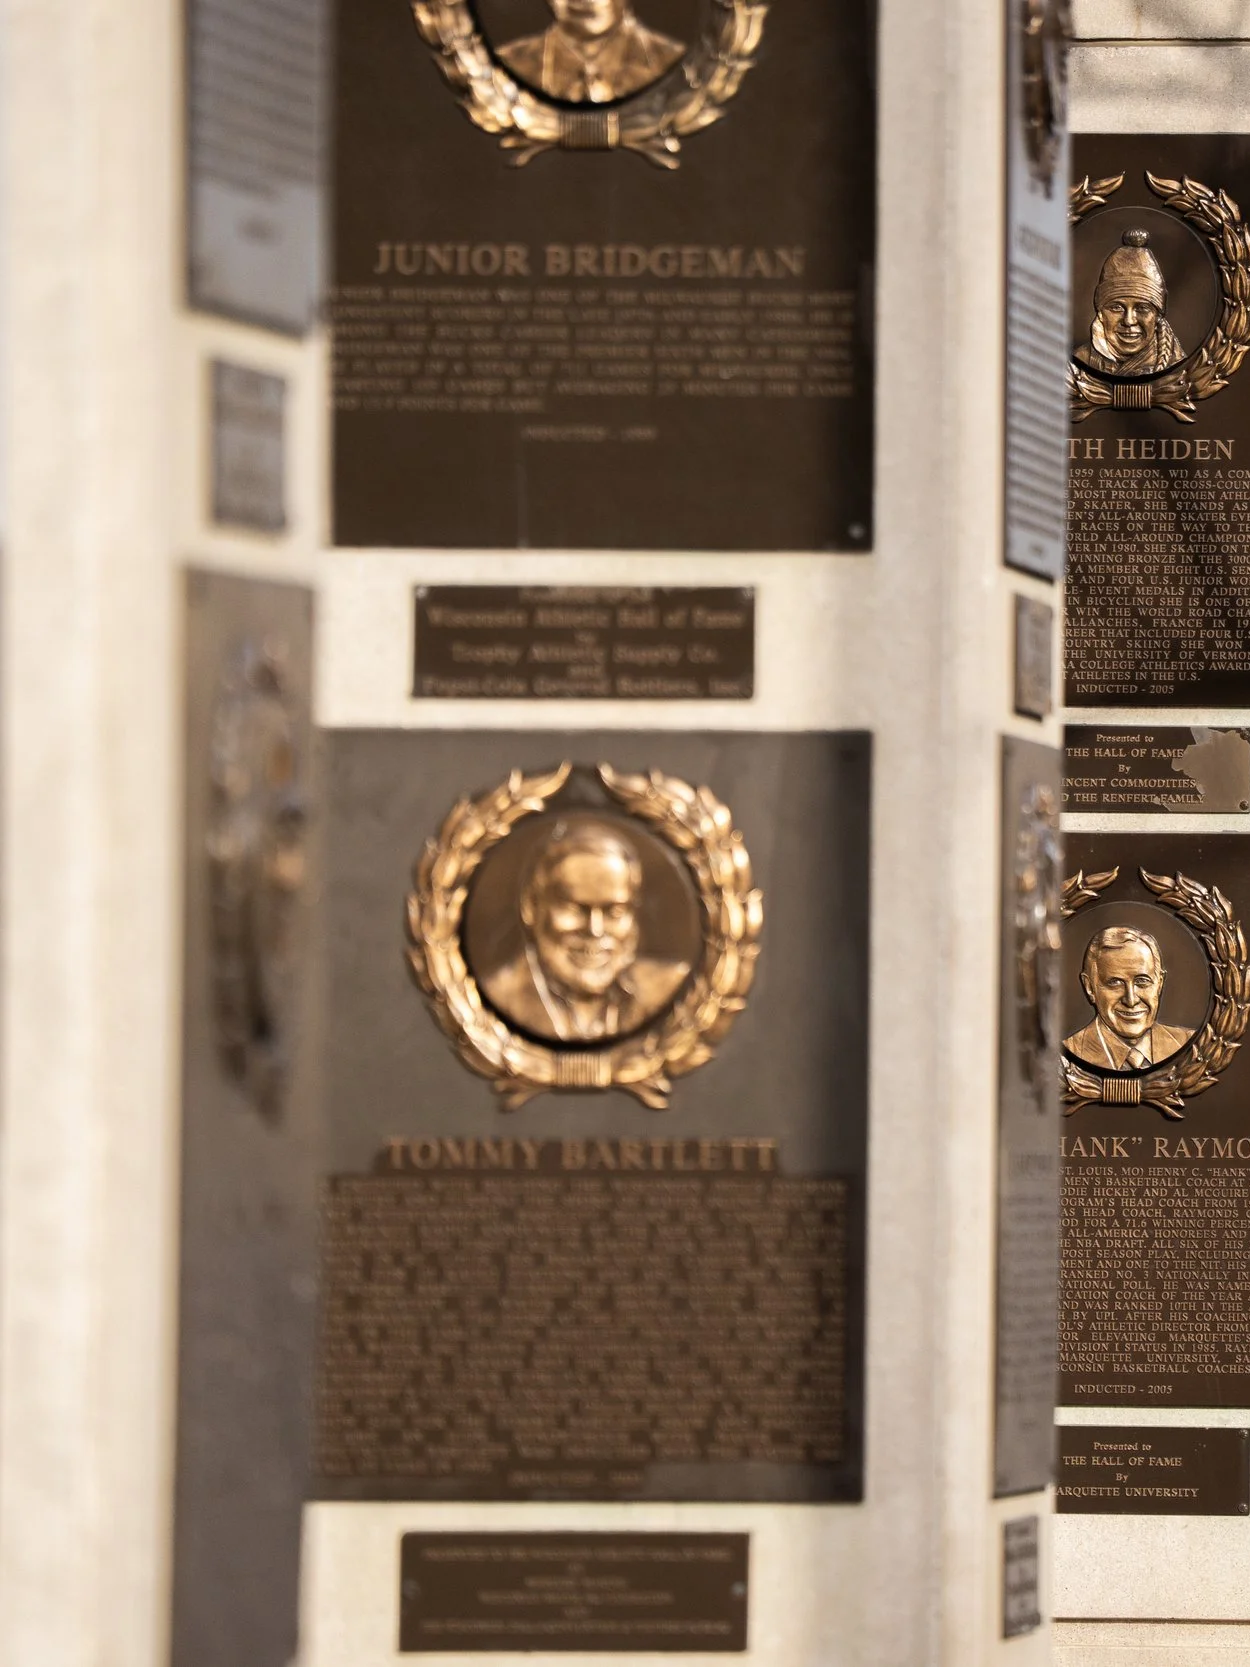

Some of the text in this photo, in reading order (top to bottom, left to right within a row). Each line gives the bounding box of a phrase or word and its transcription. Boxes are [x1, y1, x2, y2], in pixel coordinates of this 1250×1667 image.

[374, 242, 806, 279] JUNIOR BRIDGEMAN
[1116, 439, 1236, 460] HEIDEN
[1070, 468, 1093, 477] 1959
[1169, 469, 1188, 478] WI)
[1194, 469, 1209, 478] AS
[1098, 479, 1138, 488] TRACK
[1143, 479, 1169, 489] AND
[1144, 501, 1167, 510] SHE
[1176, 501, 1224, 510] STANDS
[1232, 502, 1248, 511] AS
[1104, 533, 1183, 542] ALL-AROUND
[1068, 553, 1122, 563] WINNING
[1128, 554, 1176, 563] BRONZE
[1181, 554, 1193, 564] IN
[1198, 554, 1222, 564] THE
[1067, 596, 1079, 605] IN
[1086, 596, 1153, 606] BICYCLING
[1159, 597, 1182, 606] SHE
[1188, 597, 1199, 606] IS
[1205, 597, 1230, 606] ONE
[1235, 597, 1250, 607] OF
[1152, 618, 1202, 627] FRANCE
[1213, 618, 1225, 628] IN
[1095, 650, 1170, 659] UNIVERSITY
[1179, 650, 1195, 659] OF
[1076, 684, 1138, 694] INDUCTED
[1150, 684, 1174, 694] 2005
[1096, 734, 1154, 743] Presented to
[1066, 748, 1185, 758] THE HALL OF FAME
[1118, 764, 1131, 774] By
[1110, 778, 1197, 788] COMMODITIES
[1074, 794, 1097, 802] THE
[1103, 794, 1156, 802] RENFERT
[1160, 794, 1205, 803] FAMILY
[385, 1137, 545, 1171] TOMMY
[1121, 1167, 1143, 1176] MO)
[1148, 1167, 1187, 1176] HENRY
[1064, 1176, 1100, 1186] MEN'S
[1106, 1177, 1181, 1186] BASKETBALL
[1186, 1178, 1226, 1187] COACH
[1230, 1178, 1244, 1187] AT
[1093, 1187, 1136, 1196] HICKEY
[1143, 1188, 1167, 1197] AND
[1173, 1188, 1188, 1197] AL
[1194, 1188, 1248, 1197] MCGUIRE
[1060, 1270, 1108, 1279] RANKED
[1156, 1271, 1229, 1280] NATIONALLY
[1237, 1271, 1248, 1280] IN
[1163, 1281, 1178, 1290] HE
[1185, 1281, 1209, 1290] WAS
[1089, 1322, 1145, 1331] ATHLETIC
[1151, 1322, 1210, 1331] DIRECTOR
[1216, 1323, 1248, 1332] FROM
[1124, 1343, 1166, 1352] STATUS
[1173, 1343, 1184, 1352] IN
[1059, 1352, 1131, 1361] MARQUETTE
[1074, 1385, 1135, 1394] INDUCTED
[1147, 1385, 1173, 1394] 2005
[1094, 1442, 1152, 1451] Presented to
[1063, 1456, 1182, 1466] THE HALL OF FAME
[1116, 1473, 1128, 1482] By
[1125, 1488, 1199, 1497] UNIVERSITY
